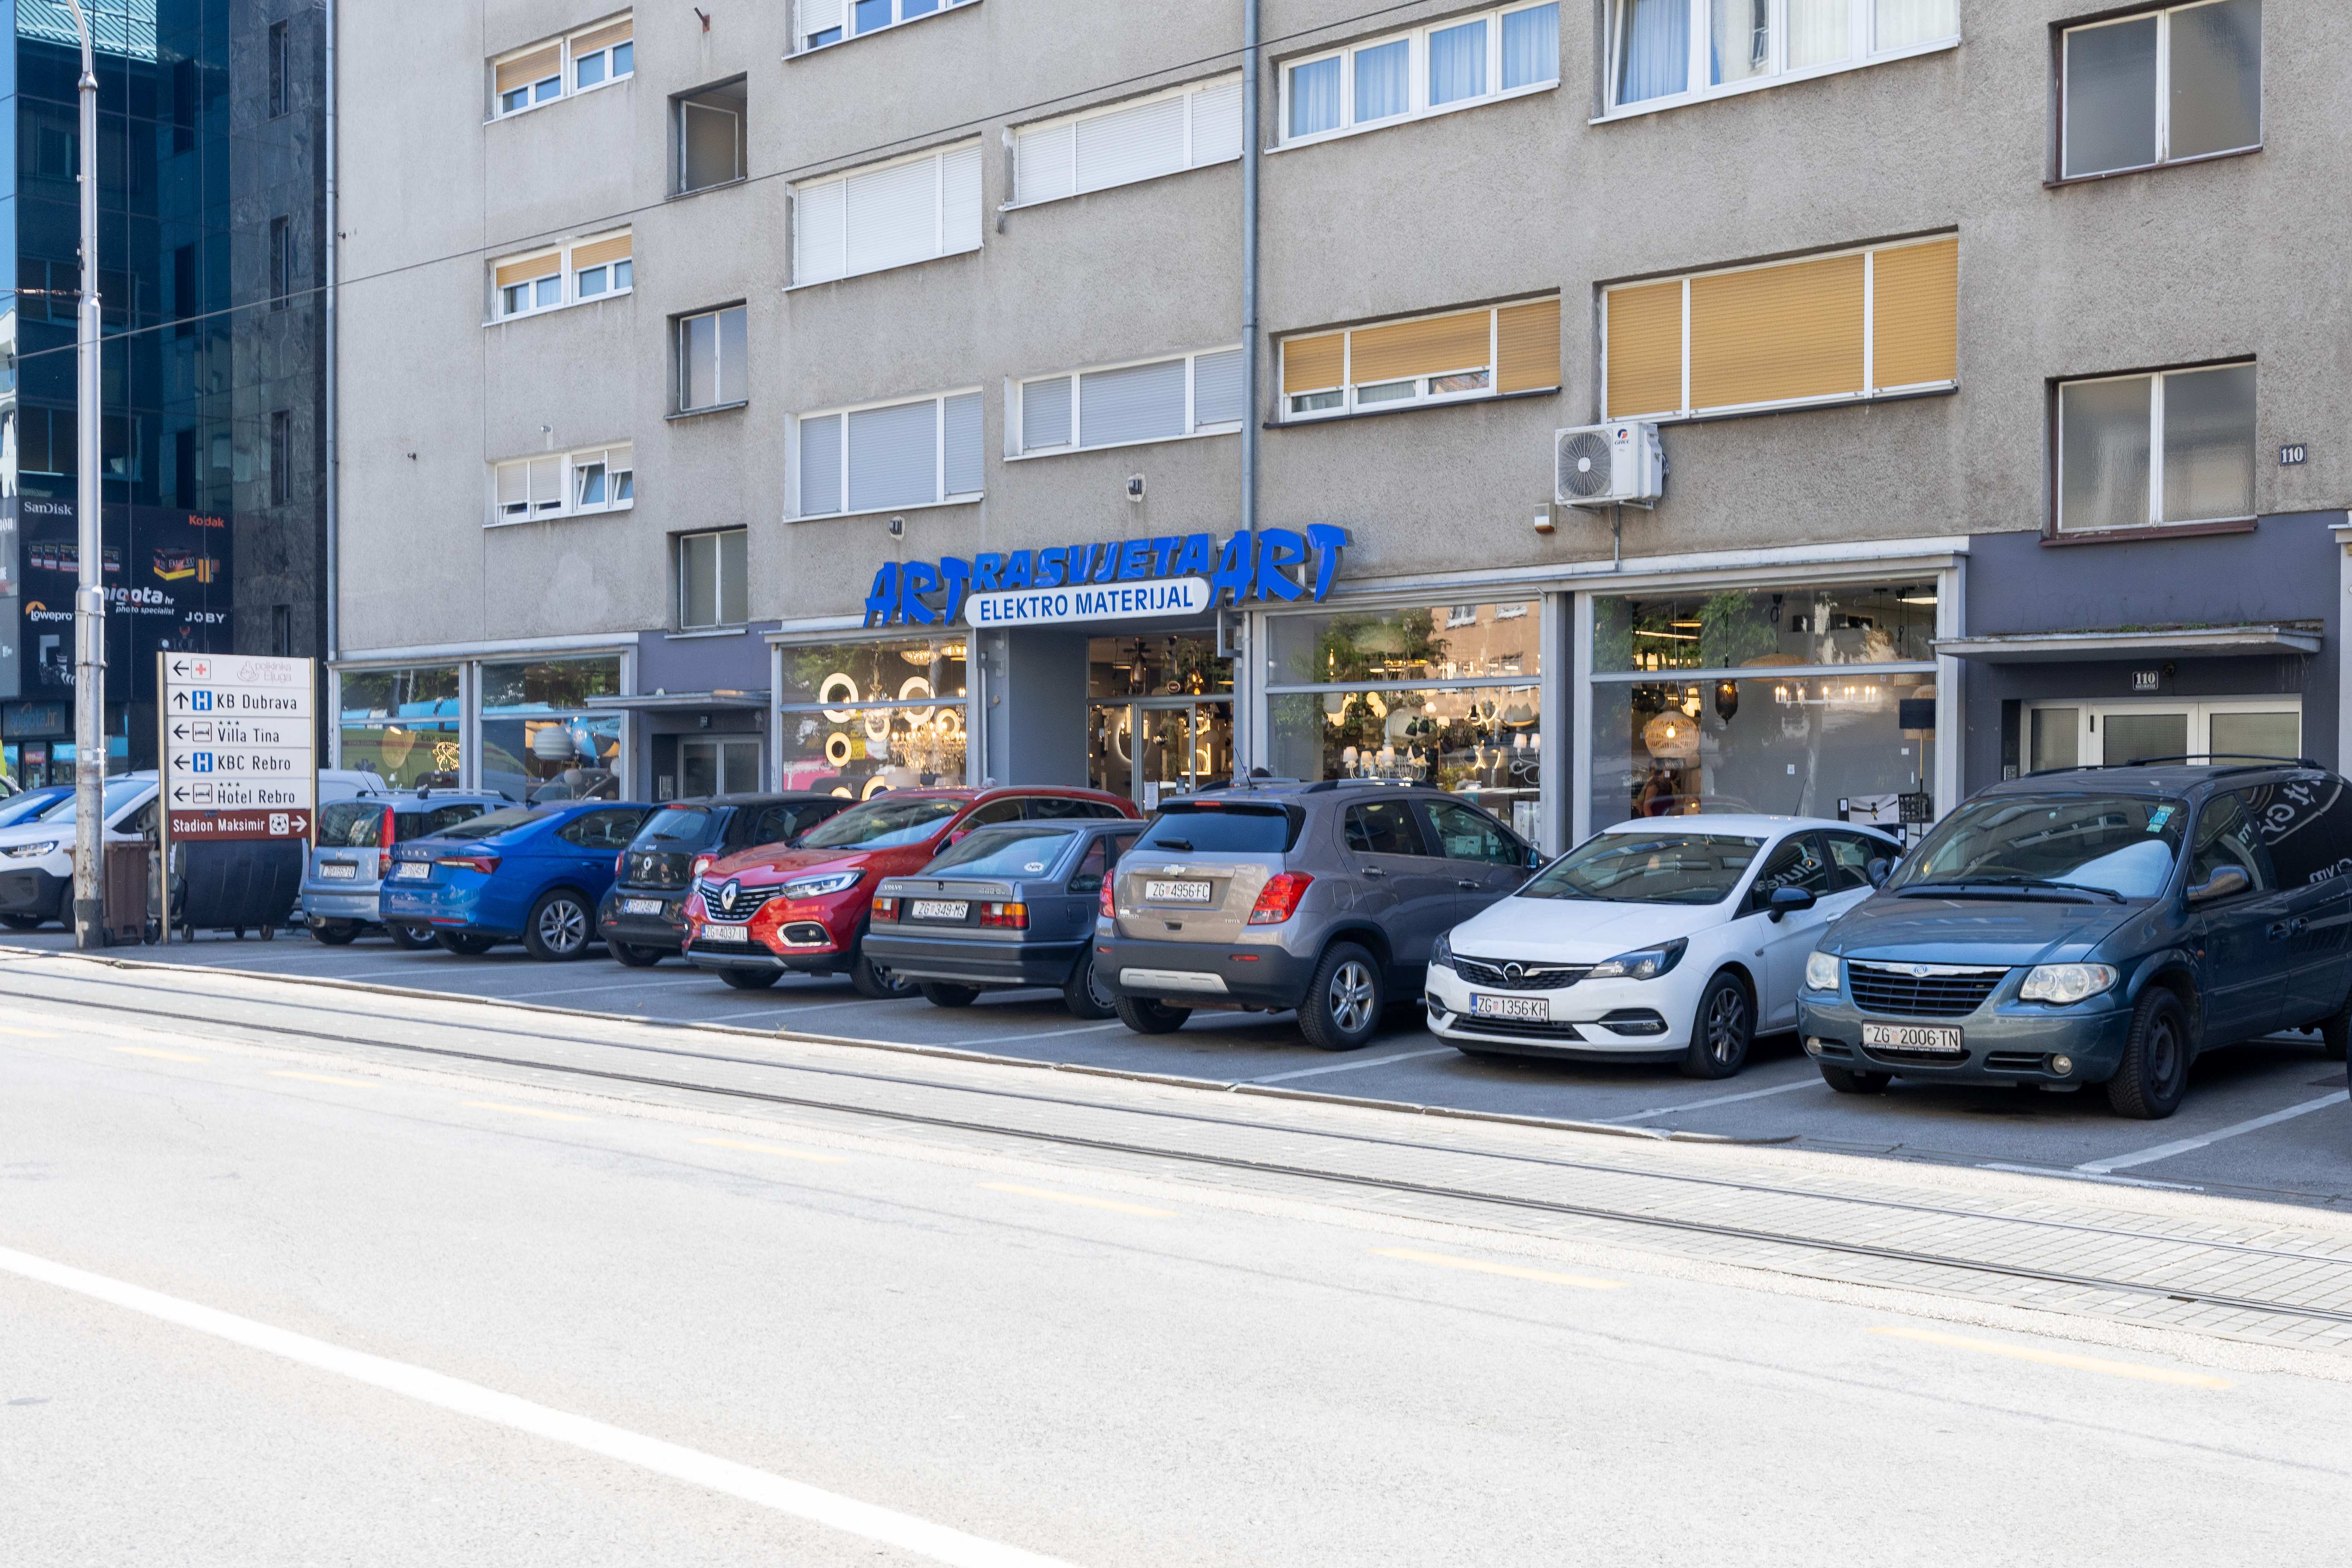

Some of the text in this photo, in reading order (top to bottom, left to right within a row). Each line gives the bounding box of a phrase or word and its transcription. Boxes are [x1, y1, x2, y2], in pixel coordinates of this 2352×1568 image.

[2282, 446, 2303, 463] 110
[24, 501, 73, 516] SanDisk
[189, 514, 225, 528] Kodak
[970, 532, 1209, 591] RASVJETA
[1199, 523, 1348, 608] ART
[102, 583, 174, 606] nigota.hr
[863, 556, 971, 629] ART
[980, 584, 1194, 621] ELEKTRO MATERIJAL
[31, 610, 73, 623] Lowepro
[116, 606, 174, 616] photo specialist
[185, 611, 225, 624] JOBY
[256, 661, 291, 671] poliklinika
[264, 671, 292, 683] Eljuga
[2136, 672, 2155, 684] 110
[217, 693, 235, 708] KB
[243, 694, 297, 709] Dubrava
[217, 727, 279, 742] Villa Tina
[218, 755, 245, 770] KBC
[252, 756, 291, 770] Rebro
[218, 790, 295, 804] Hotel Rebro
[173, 818, 266, 833] Stadion Maksimir
[1153, 883, 1164, 896] ZG
[919, 903, 930, 915] ZG
[707, 926, 715, 938] ZG
[1479, 998, 1492, 1012] ZG
[1874, 1027, 1958, 1047] ZG 2006-TN
